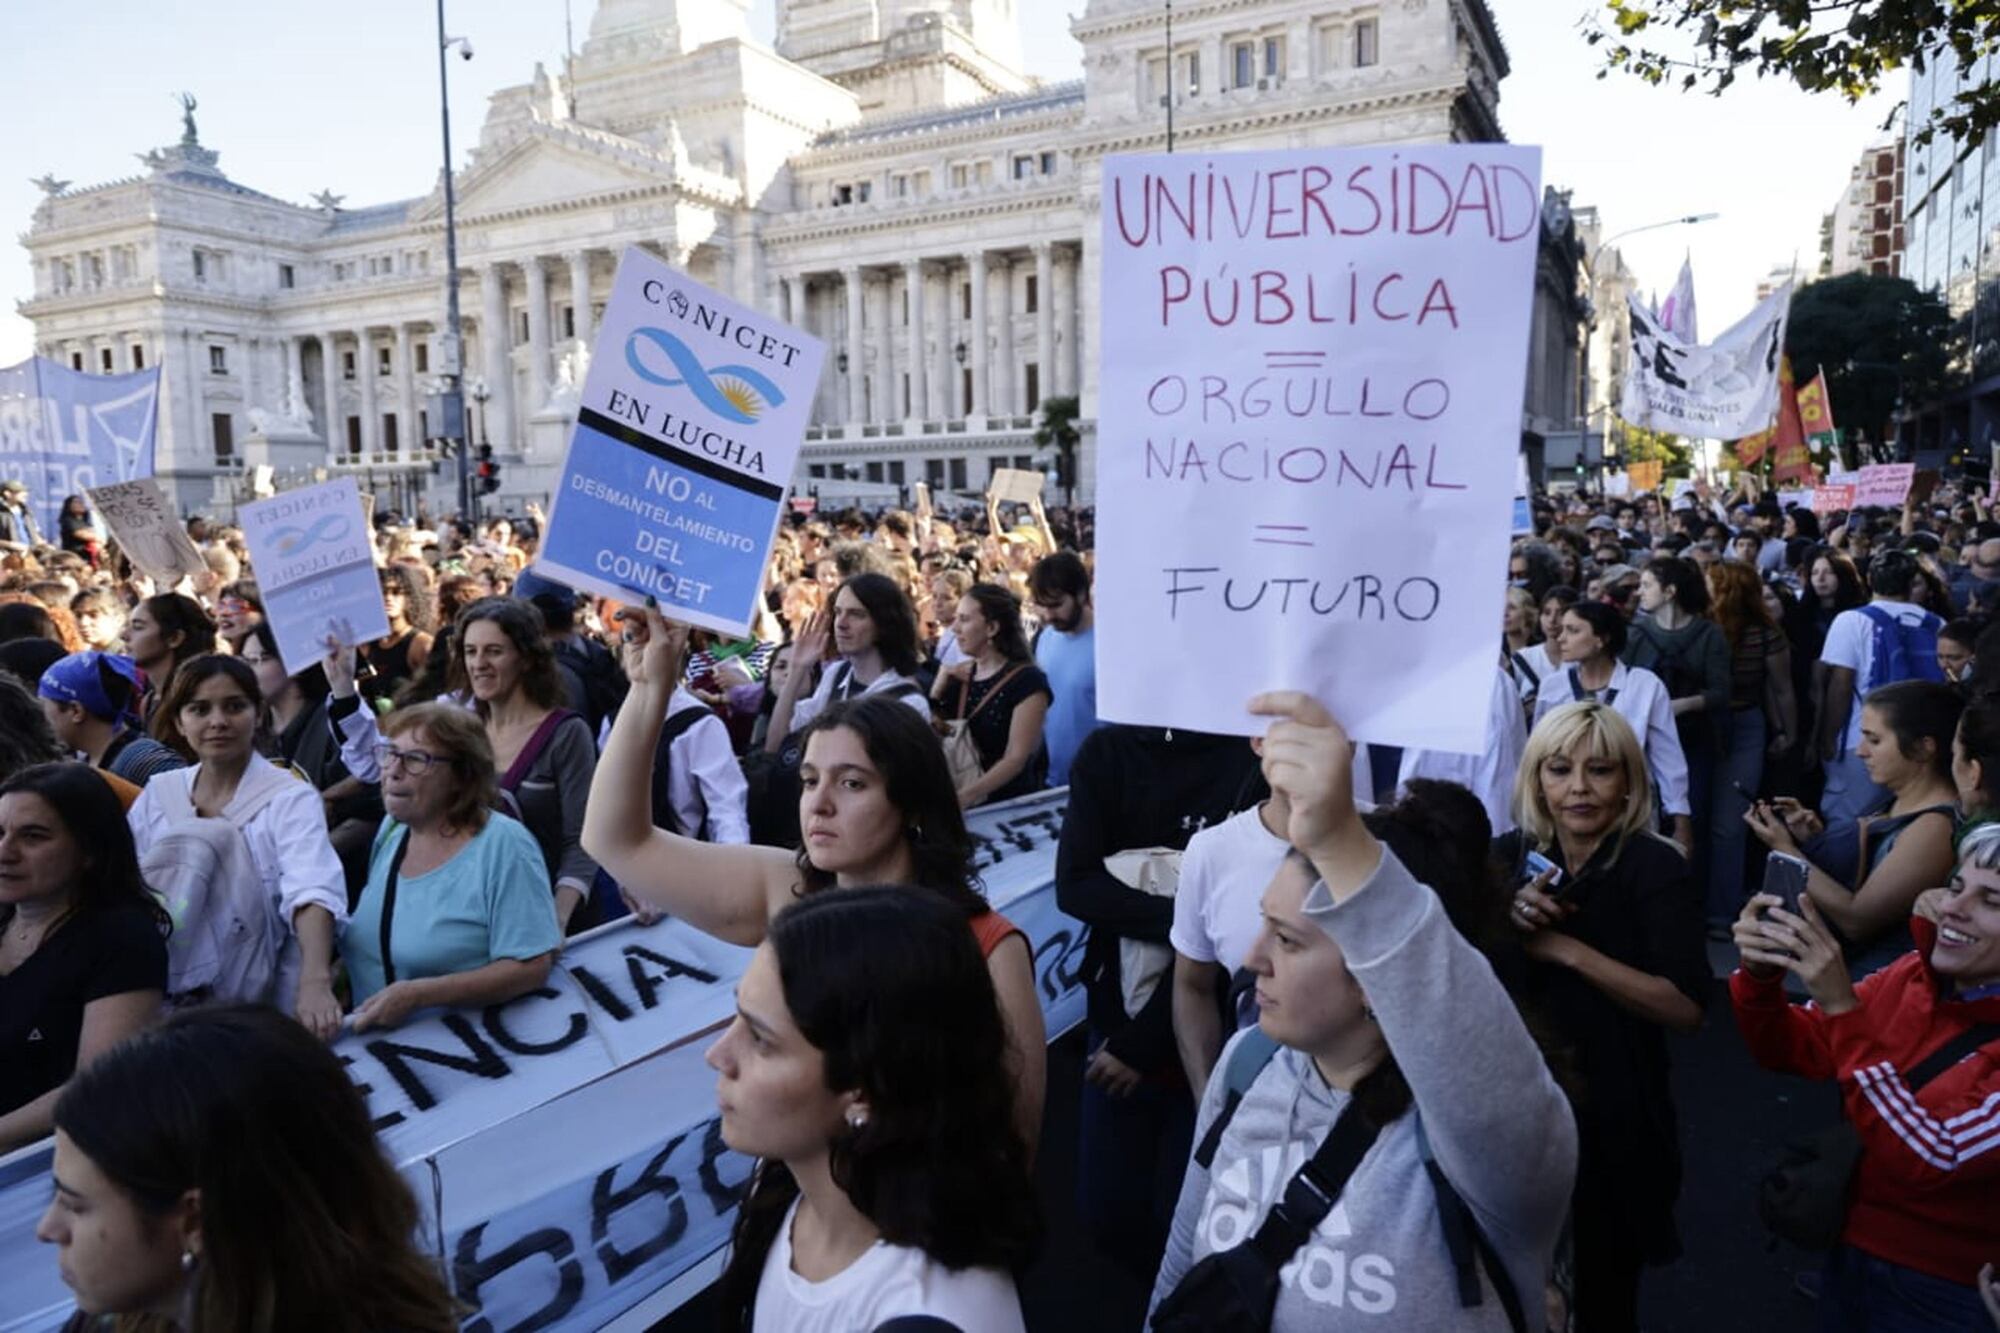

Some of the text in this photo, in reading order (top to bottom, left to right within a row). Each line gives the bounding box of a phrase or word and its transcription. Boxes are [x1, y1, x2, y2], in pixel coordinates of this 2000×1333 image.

[1115, 154, 1538, 248] UNIVERSIDAD
[1159, 262, 1459, 329] PÚBLICA
[1147, 375, 1451, 424] ORGULLO
[608, 389, 767, 475] EN LUCHA
[645, 465, 718, 512] NO AL
[1145, 437, 1467, 491] NACIONAL
[572, 473, 754, 554] DESMANTELAMIENTO
[635, 531, 684, 566] DEL
[596, 549, 713, 604] CONICET
[1162, 566, 1440, 622] FUTURO
